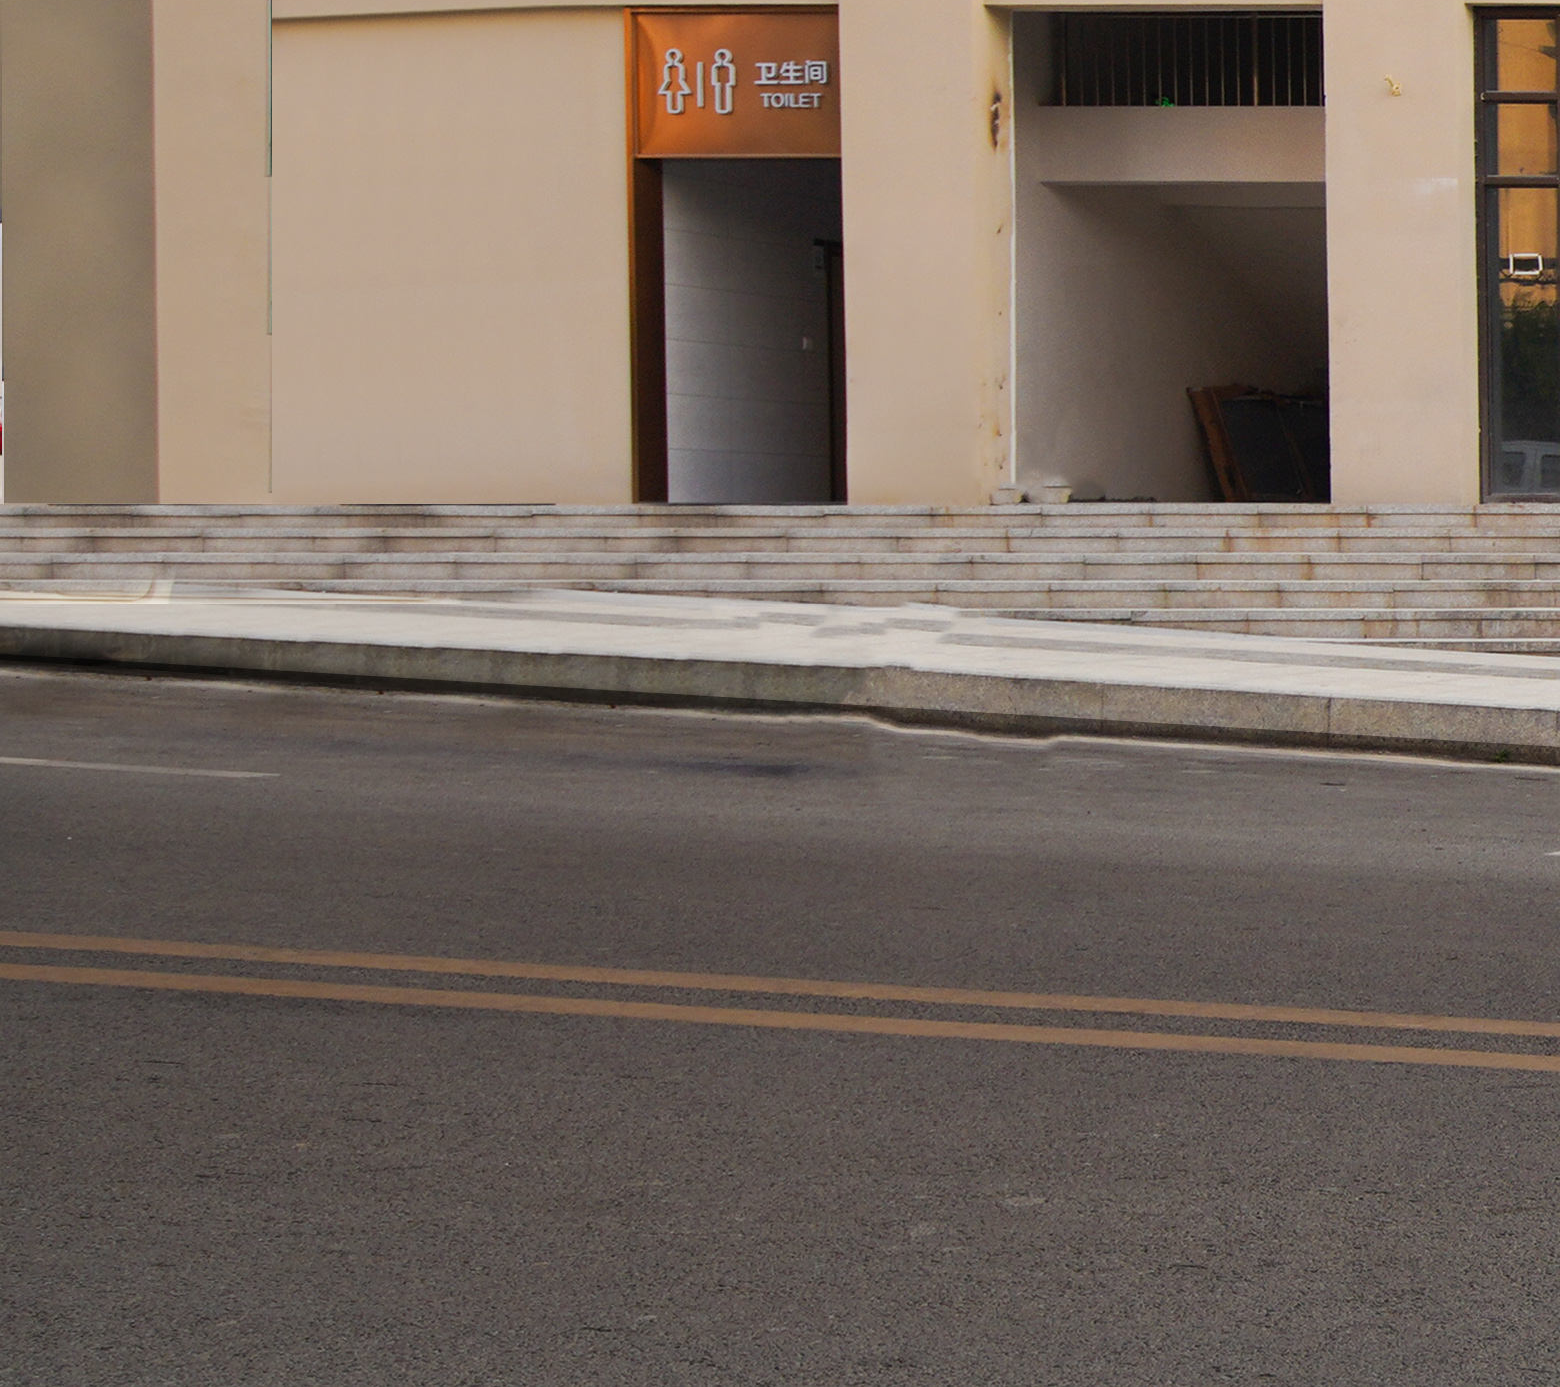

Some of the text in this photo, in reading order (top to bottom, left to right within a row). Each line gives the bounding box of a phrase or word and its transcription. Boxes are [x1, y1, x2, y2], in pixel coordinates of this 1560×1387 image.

[754, 60, 827, 85] 卫生间
[760, 92, 822, 108] TOILET
